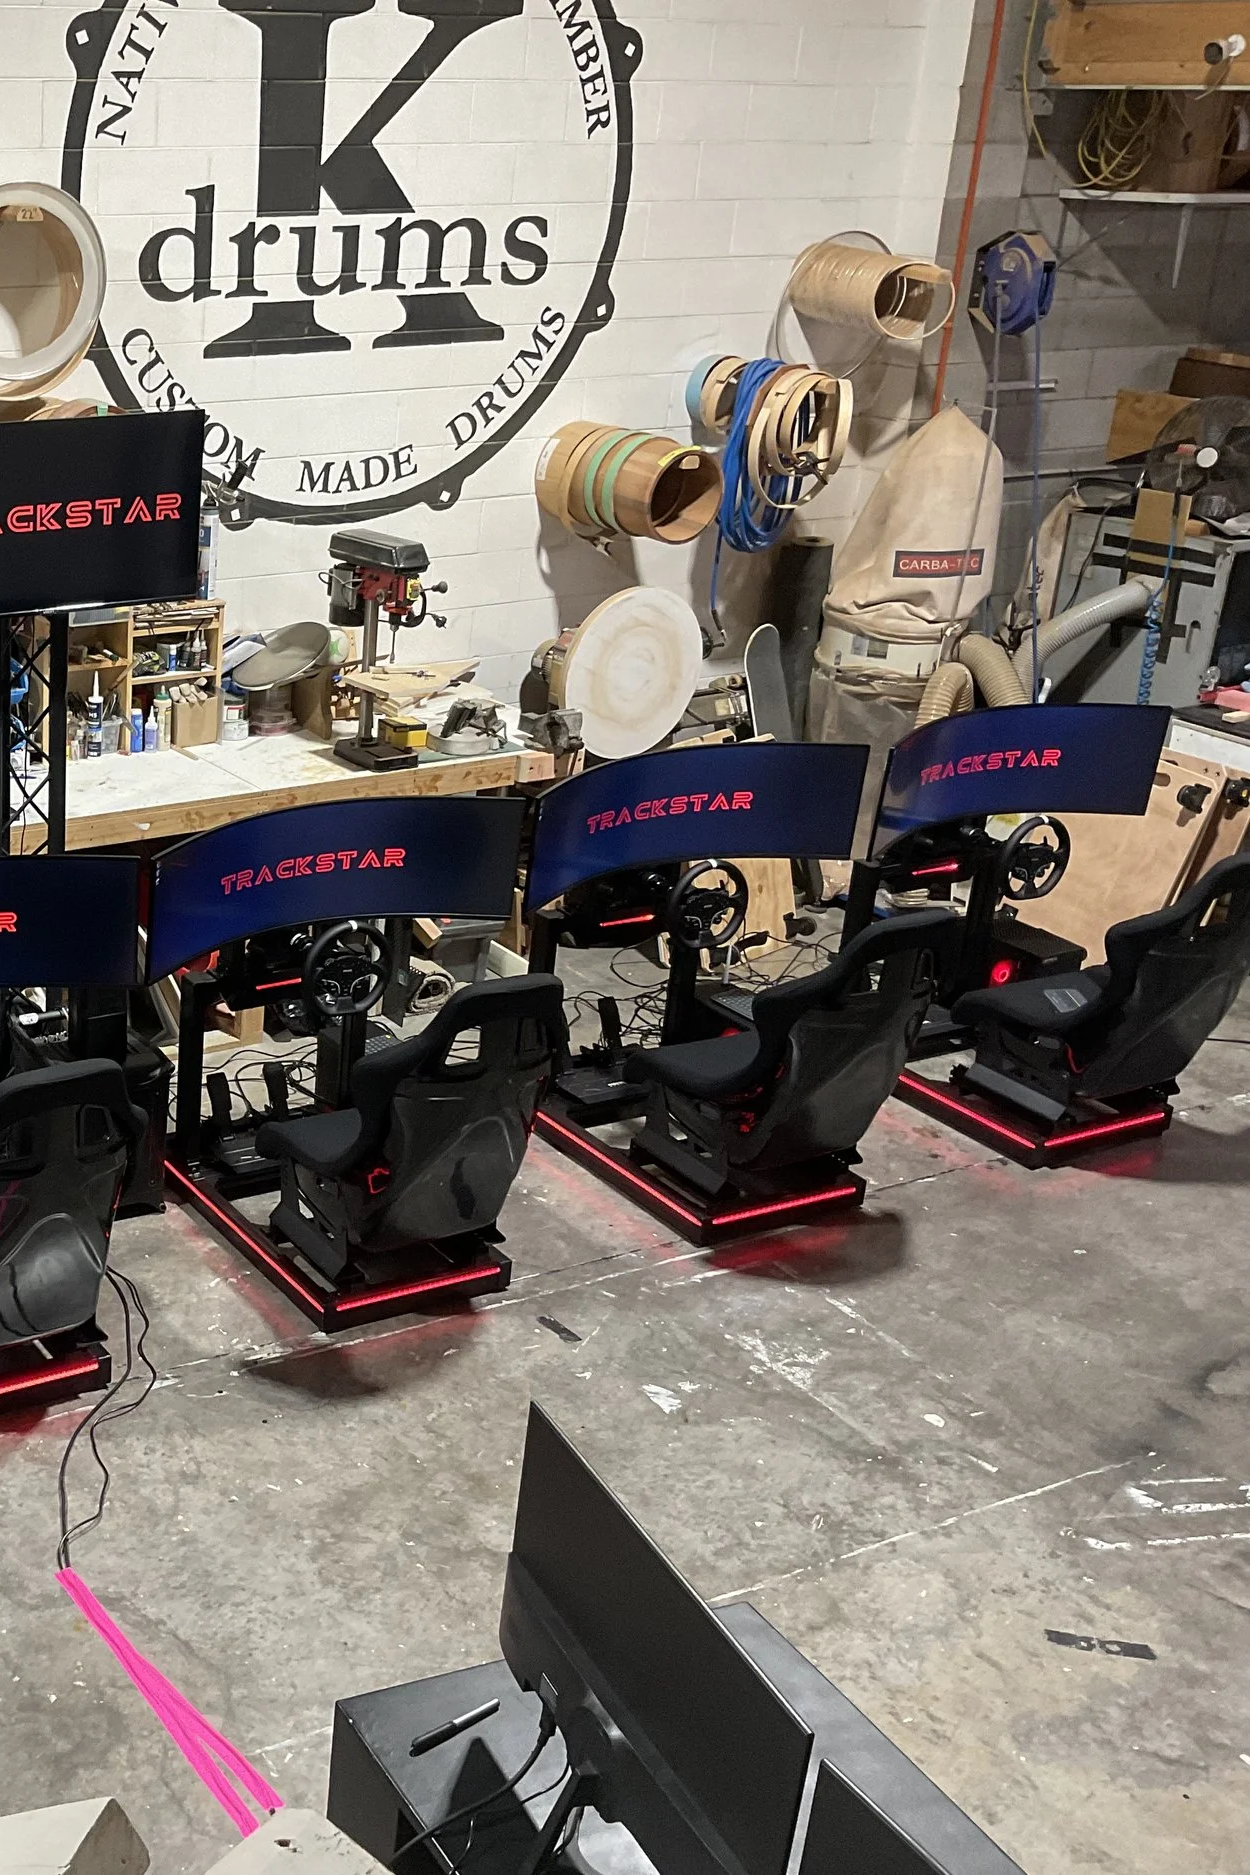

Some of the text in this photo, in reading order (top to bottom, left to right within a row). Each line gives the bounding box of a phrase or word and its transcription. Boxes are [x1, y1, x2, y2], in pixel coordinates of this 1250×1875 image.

[95, 0, 179, 146] NATI
[549, 0, 611, 140] MBER
[138, 184, 548, 302] drums
[121, 306, 566, 495] CUSOM MADE DRUMS
[589, 791, 755, 834] TRACKSTAR
[922, 748, 1063, 783] TRACKSTAR
[222, 847, 407, 895] TRACKSTAR
